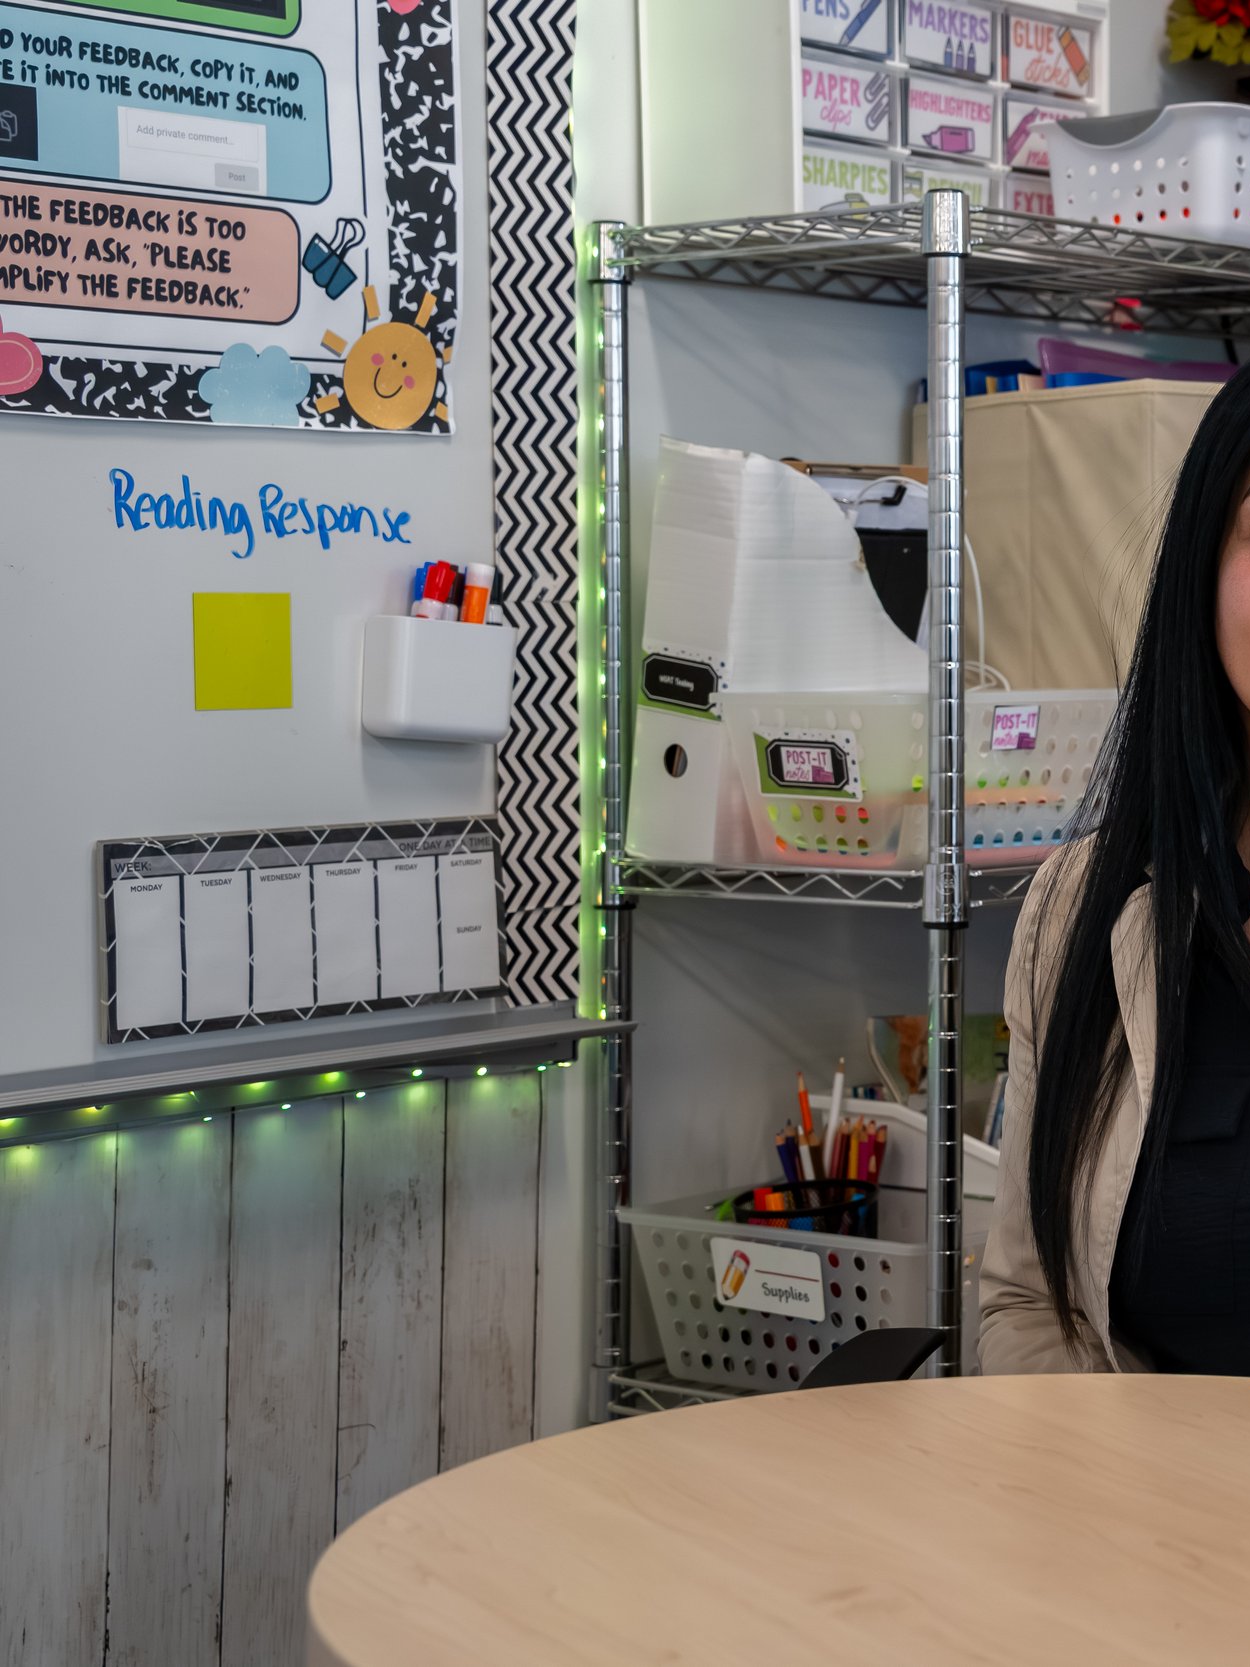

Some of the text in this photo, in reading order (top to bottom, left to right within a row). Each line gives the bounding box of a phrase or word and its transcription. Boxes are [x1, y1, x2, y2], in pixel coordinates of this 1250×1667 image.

[907, 0, 990, 43] MARKERS
[1013, 20, 1055, 55] GLUE
[21, 32, 72, 58] YOUR
[79, 42, 185, 77] FEEDBACK,
[190, 59, 234, 81] COPY
[265, 69, 300, 91] AND
[1025, 54, 1070, 88] sticks
[96, 74, 132, 97] THE
[138, 80, 230, 109] COMMENT
[801, 68, 861, 107] PAPER
[820, 103, 852, 130] clips
[908, 89, 992, 124] HIGHLIGHTERS
[136, 124, 156, 137] Add
[157, 127, 186, 141] private
[228, 172, 246, 182] Post
[802, 155, 888, 195] SHARPIES
[0, 195, 42, 220] THE
[50, 199, 170, 234] FEEDBACK
[205, 216, 246, 241] TOO
[84, 237, 137, 269] ASK,
[143, 242, 232, 273] "PLEASE
[77, 273, 119, 297] THE
[127, 277, 250, 309] FEEDBACK."
[109, 468, 412, 559] Reading Response
[995, 712, 1038, 730] POST-IT
[786, 749, 828, 766] POST-IT
[785, 767, 812, 780] notes
[399, 842, 419, 852] ONE
[423, 841, 442, 850] DAY
[469, 836, 490, 847] TIME
[115, 861, 152, 873] WEEK:
[325, 867, 361, 878] THURSDAY
[394, 863, 418, 872] FRIDAY
[450, 858, 483, 868] SATURDAY
[200, 877, 233, 888] TUESDAY
[259, 872, 302, 883] WEDNESDAY
[130, 883, 163, 893] MONDAY
[456, 924, 482, 934] SUNDAY
[761, 1281, 811, 1304] Supplies
